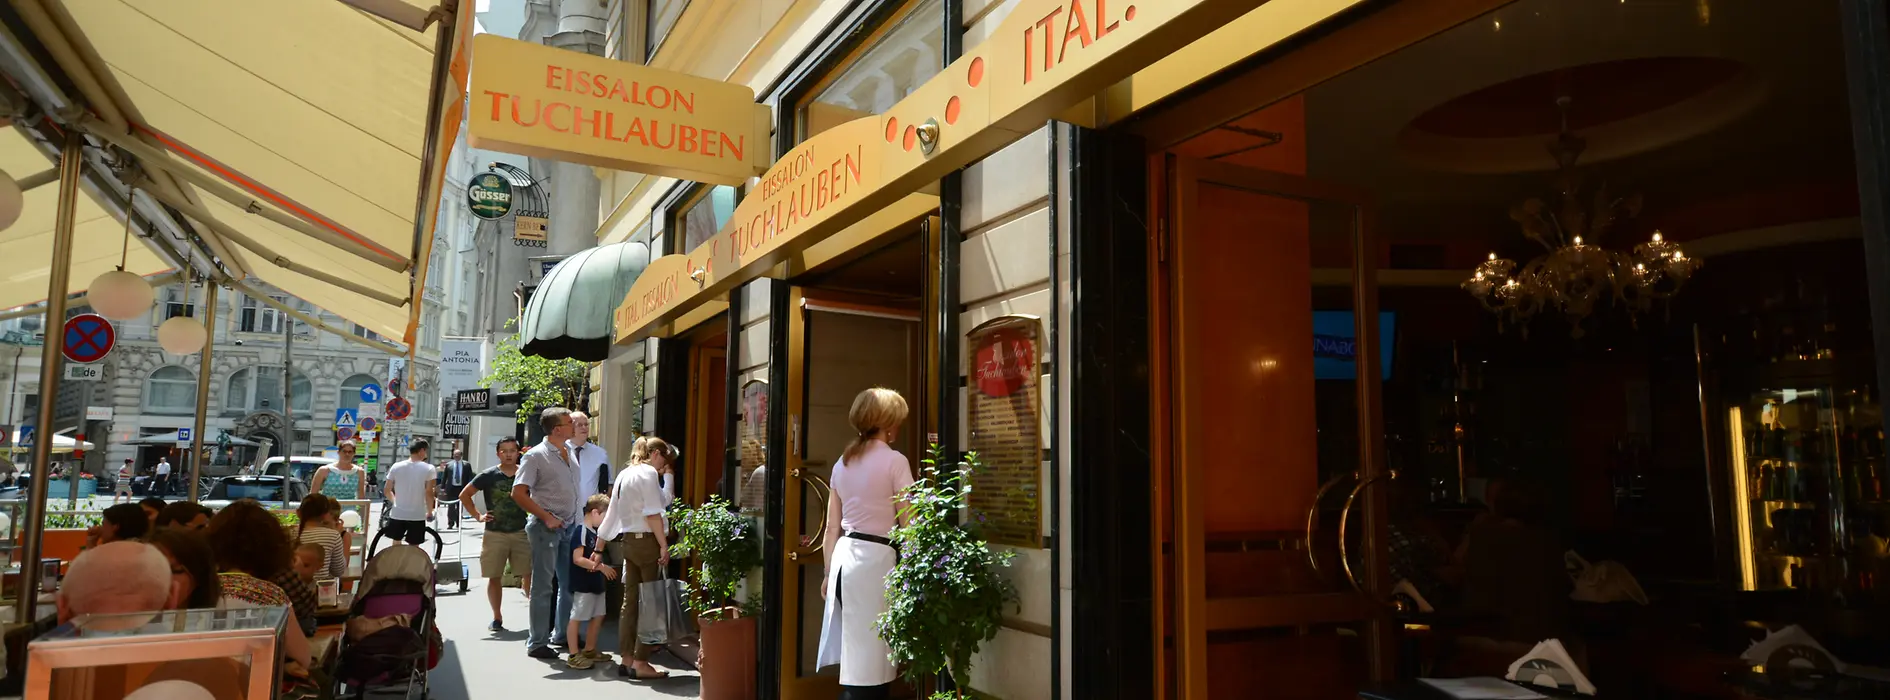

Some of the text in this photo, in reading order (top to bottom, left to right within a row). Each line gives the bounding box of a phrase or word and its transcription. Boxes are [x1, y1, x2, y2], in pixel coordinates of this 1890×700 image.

[1023, 0, 1136, 85] ITAL.
[546, 65, 694, 114] EISSALON
[484, 90, 744, 161] TUCHLAUBEN
[469, 185, 510, 203] Gösser
[763, 145, 814, 202] EISSALON
[730, 144, 861, 263] TUCHLAUBEN
[642, 270, 679, 318] EISSALON
[445, 413, 470, 424] ACTORS
[460, 391, 487, 403] HANRO
[445, 424, 470, 435] STUDIO
